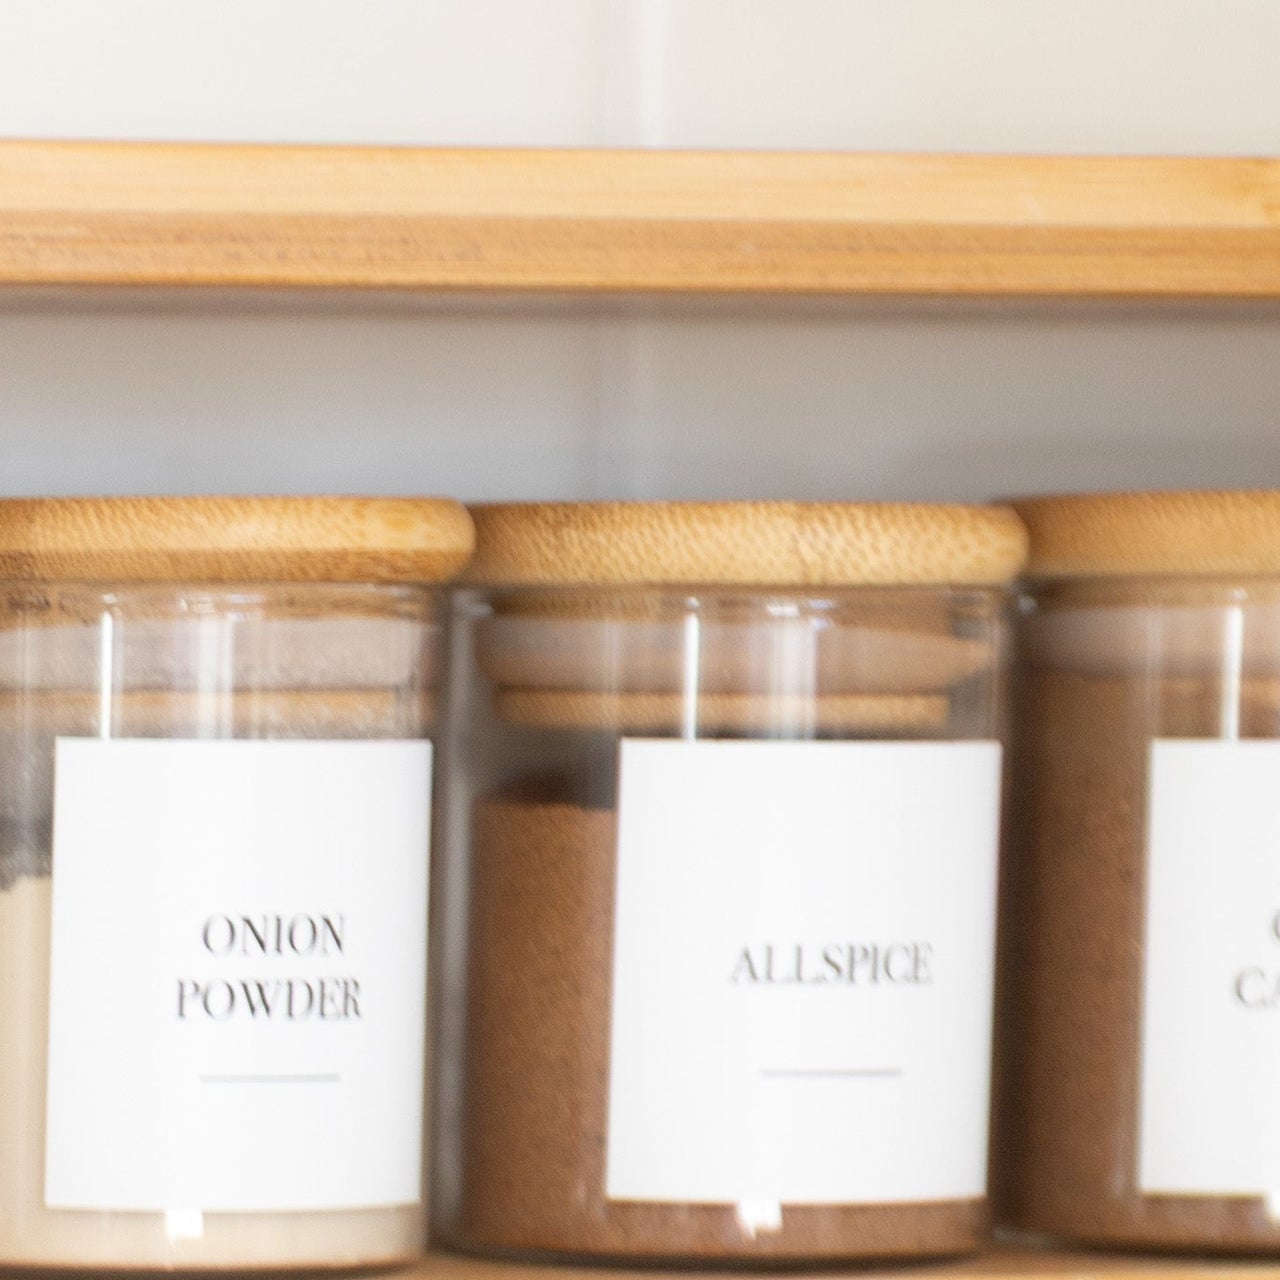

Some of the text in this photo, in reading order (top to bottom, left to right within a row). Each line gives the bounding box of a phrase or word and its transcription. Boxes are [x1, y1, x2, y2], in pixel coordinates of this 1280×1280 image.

[202, 914, 344, 953] ONION
[733, 941, 933, 986] ALLSPICE
[178, 979, 363, 1022] POWDER
